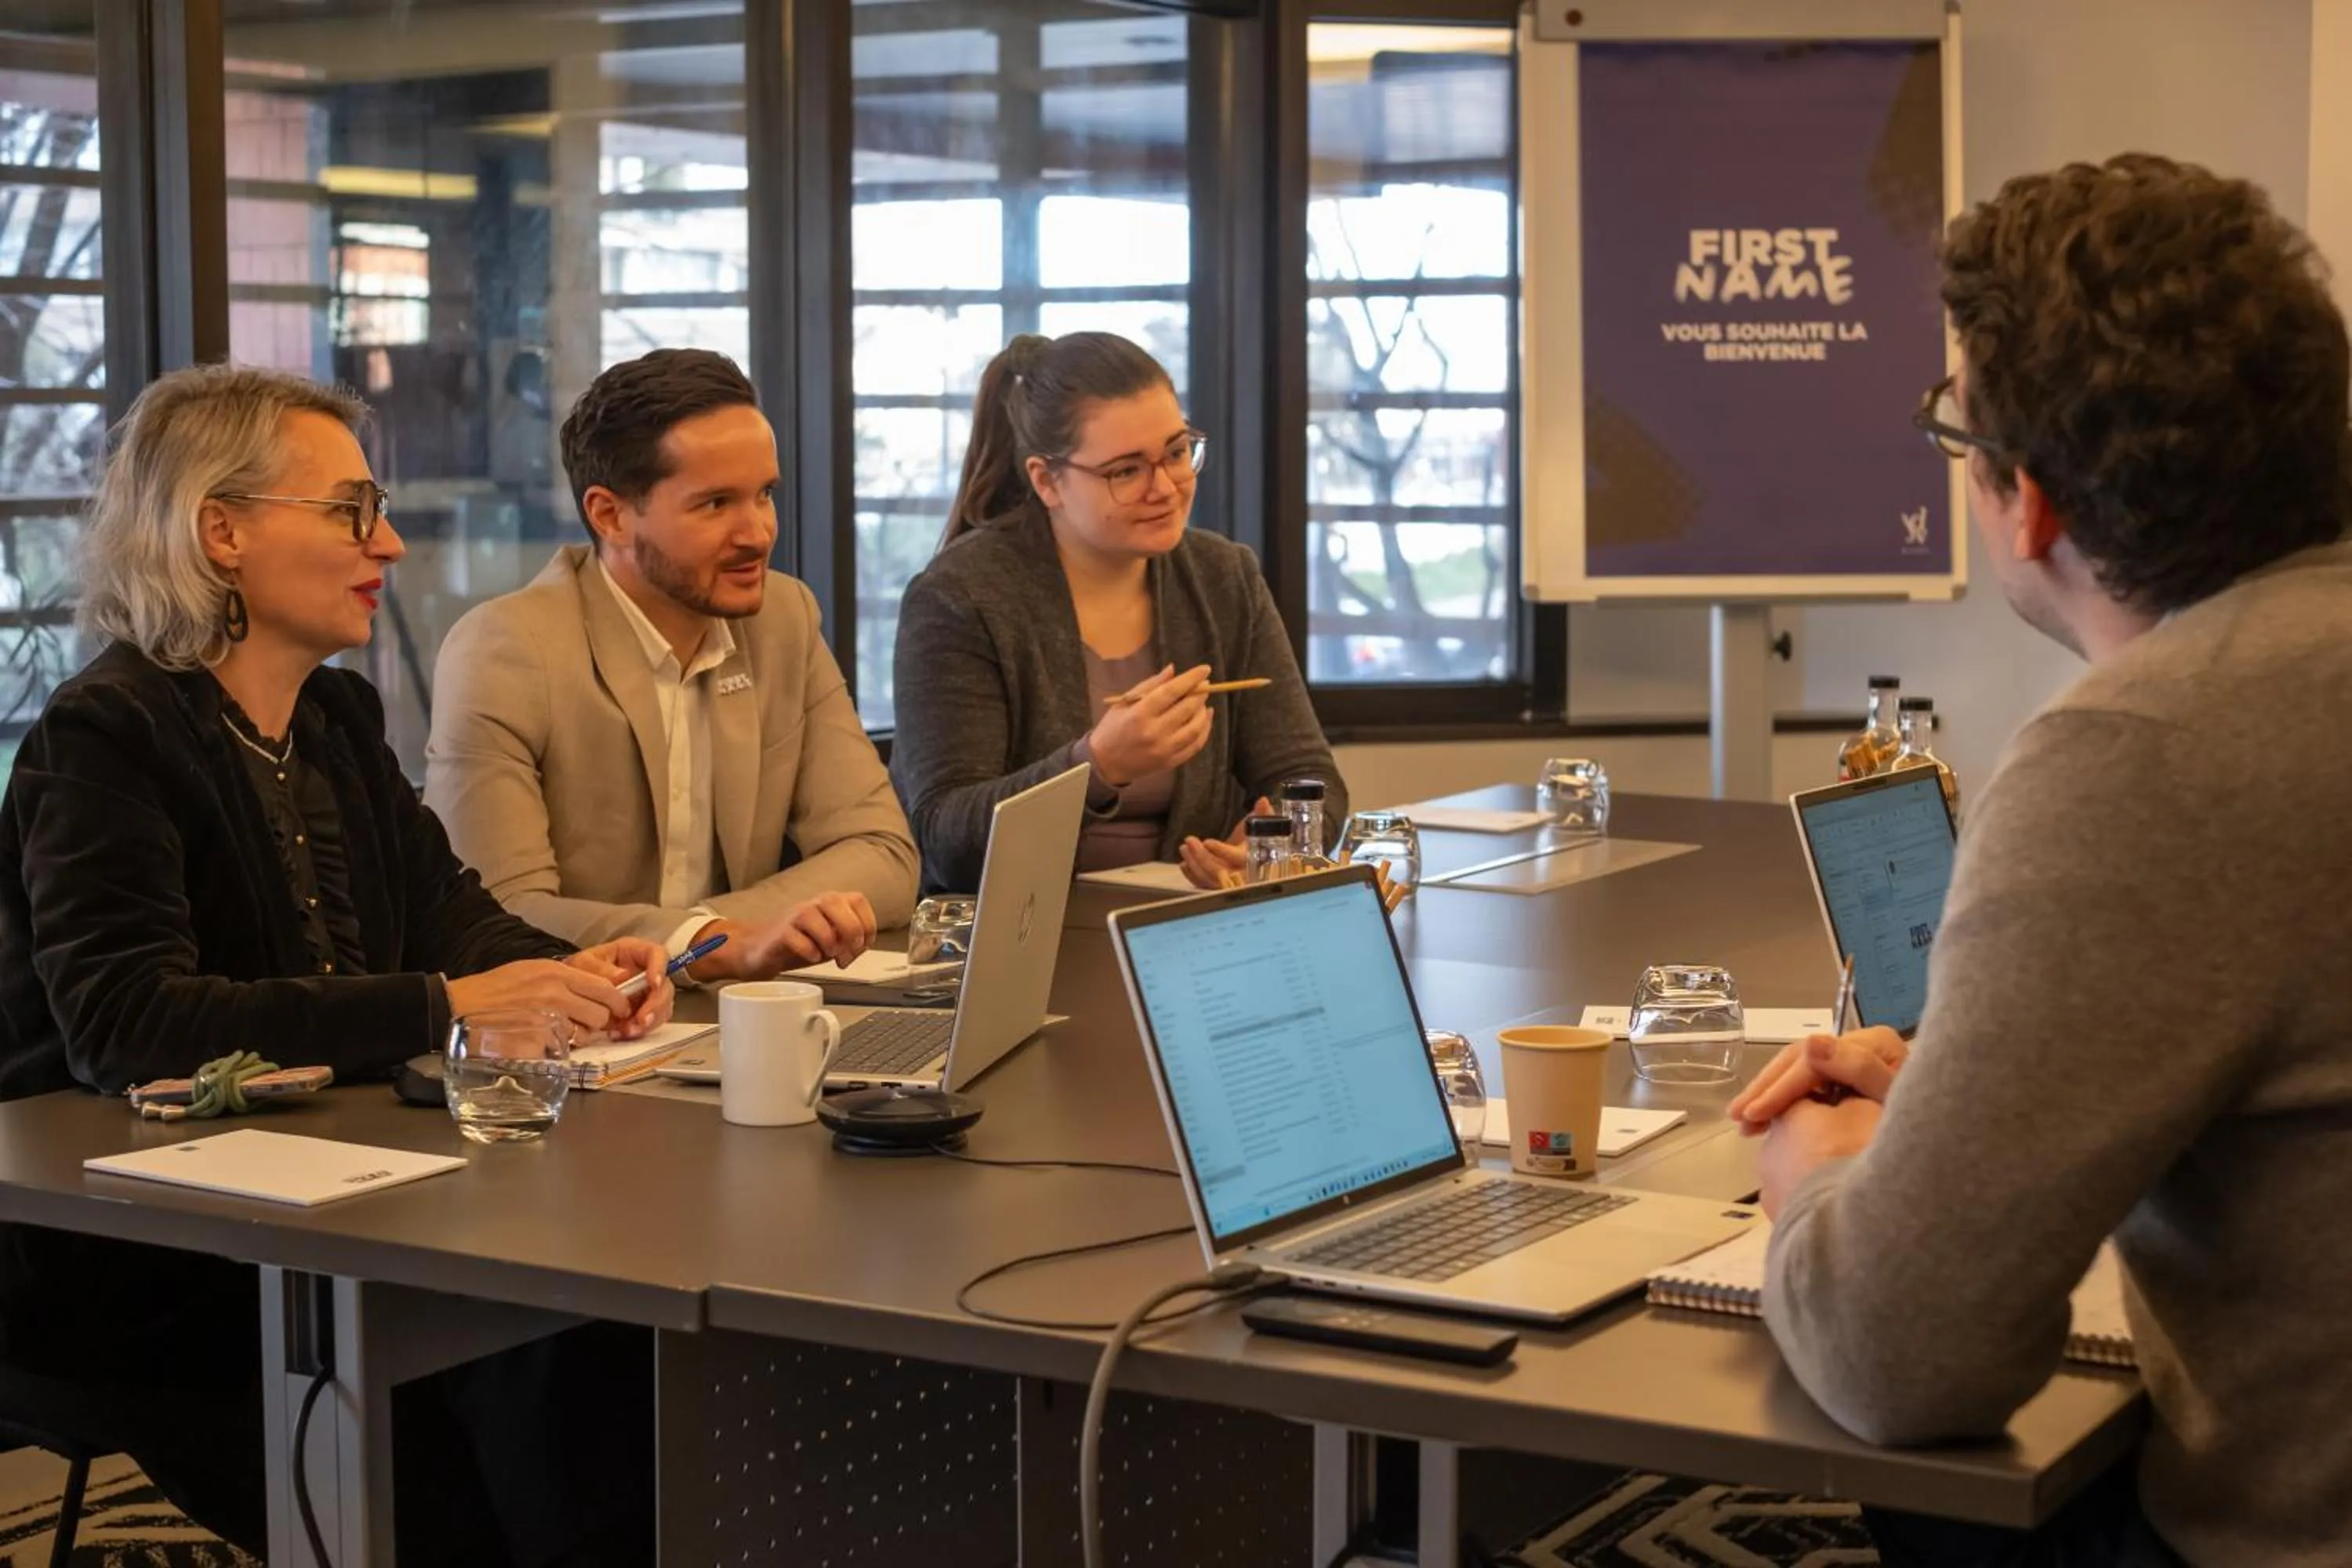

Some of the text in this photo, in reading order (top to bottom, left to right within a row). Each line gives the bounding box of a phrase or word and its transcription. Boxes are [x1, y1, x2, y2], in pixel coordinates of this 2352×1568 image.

[1690, 228, 1839, 266] FIRST
[1675, 256, 1853, 305] NAME
[1661, 322, 1868, 341] VOUS SOUHAITE LA
[1704, 343, 1827, 361] BIENVENUE
